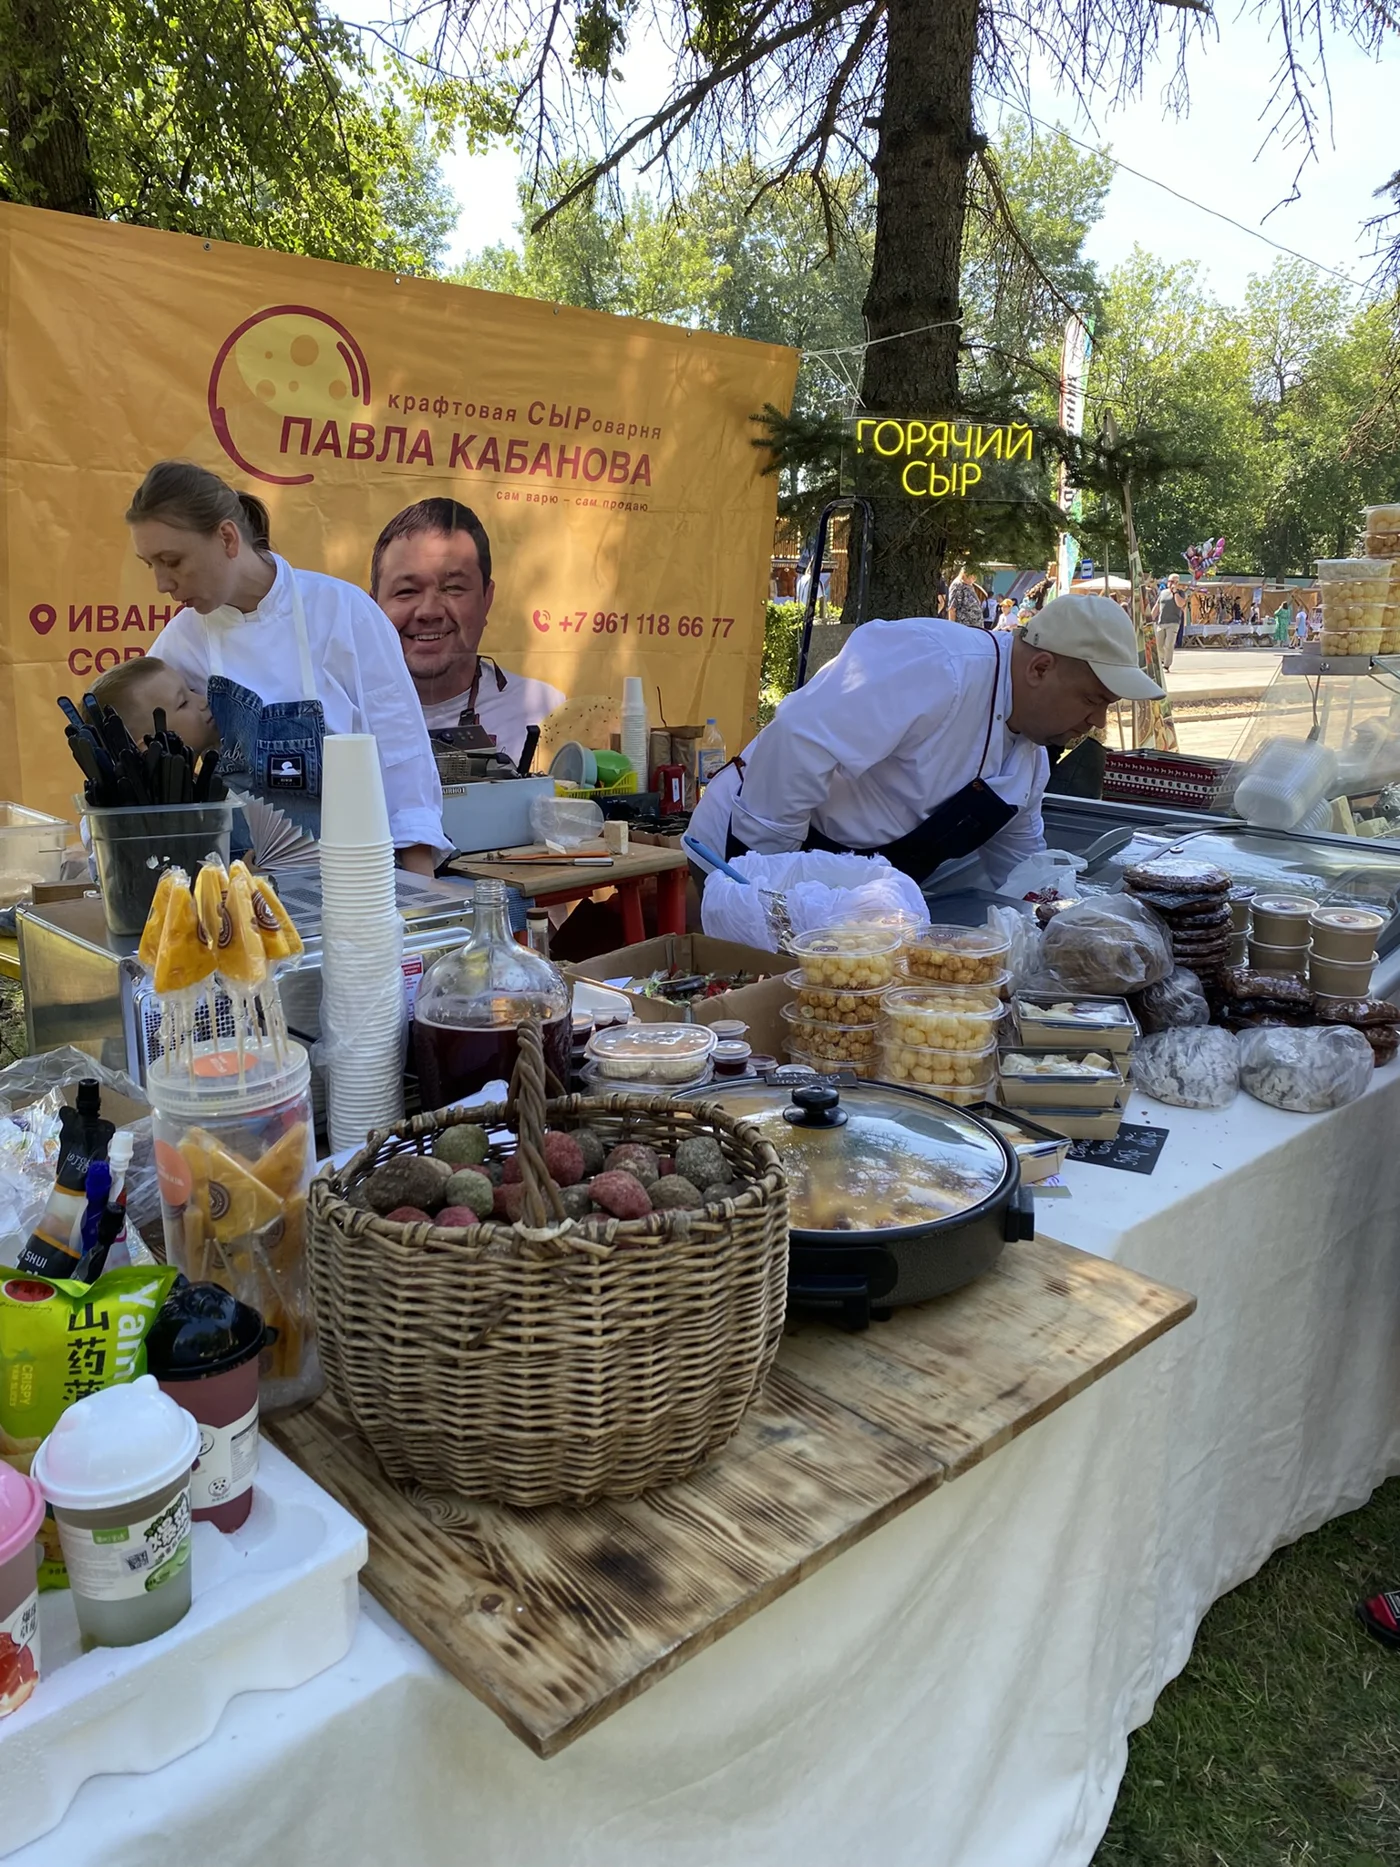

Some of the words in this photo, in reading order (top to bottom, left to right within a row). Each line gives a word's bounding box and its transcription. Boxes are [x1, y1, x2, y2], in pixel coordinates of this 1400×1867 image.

[388, 393, 517, 422] крафтовая
[528, 401, 662, 440] СЫРоварня
[279, 416, 434, 466] ПАВЛА
[449, 433, 652, 487] КАБАНОВА
[857, 420, 1032, 460] ГОРЯЧИЙ
[902, 460, 982, 496] СЫР
[496, 491, 520, 501] сам
[526, 492, 558, 505] варю
[575, 497, 597, 507] сам
[603, 500, 648, 512] продаю
[69, 604, 186, 632] ИВАН
[559, 611, 588, 633] +7
[592, 612, 629, 634] 961
[636, 613, 670, 636] 118
[677, 615, 704, 637] 66
[711, 618, 735, 638] 77
[20, 1364, 33, 1405] CRISPY
